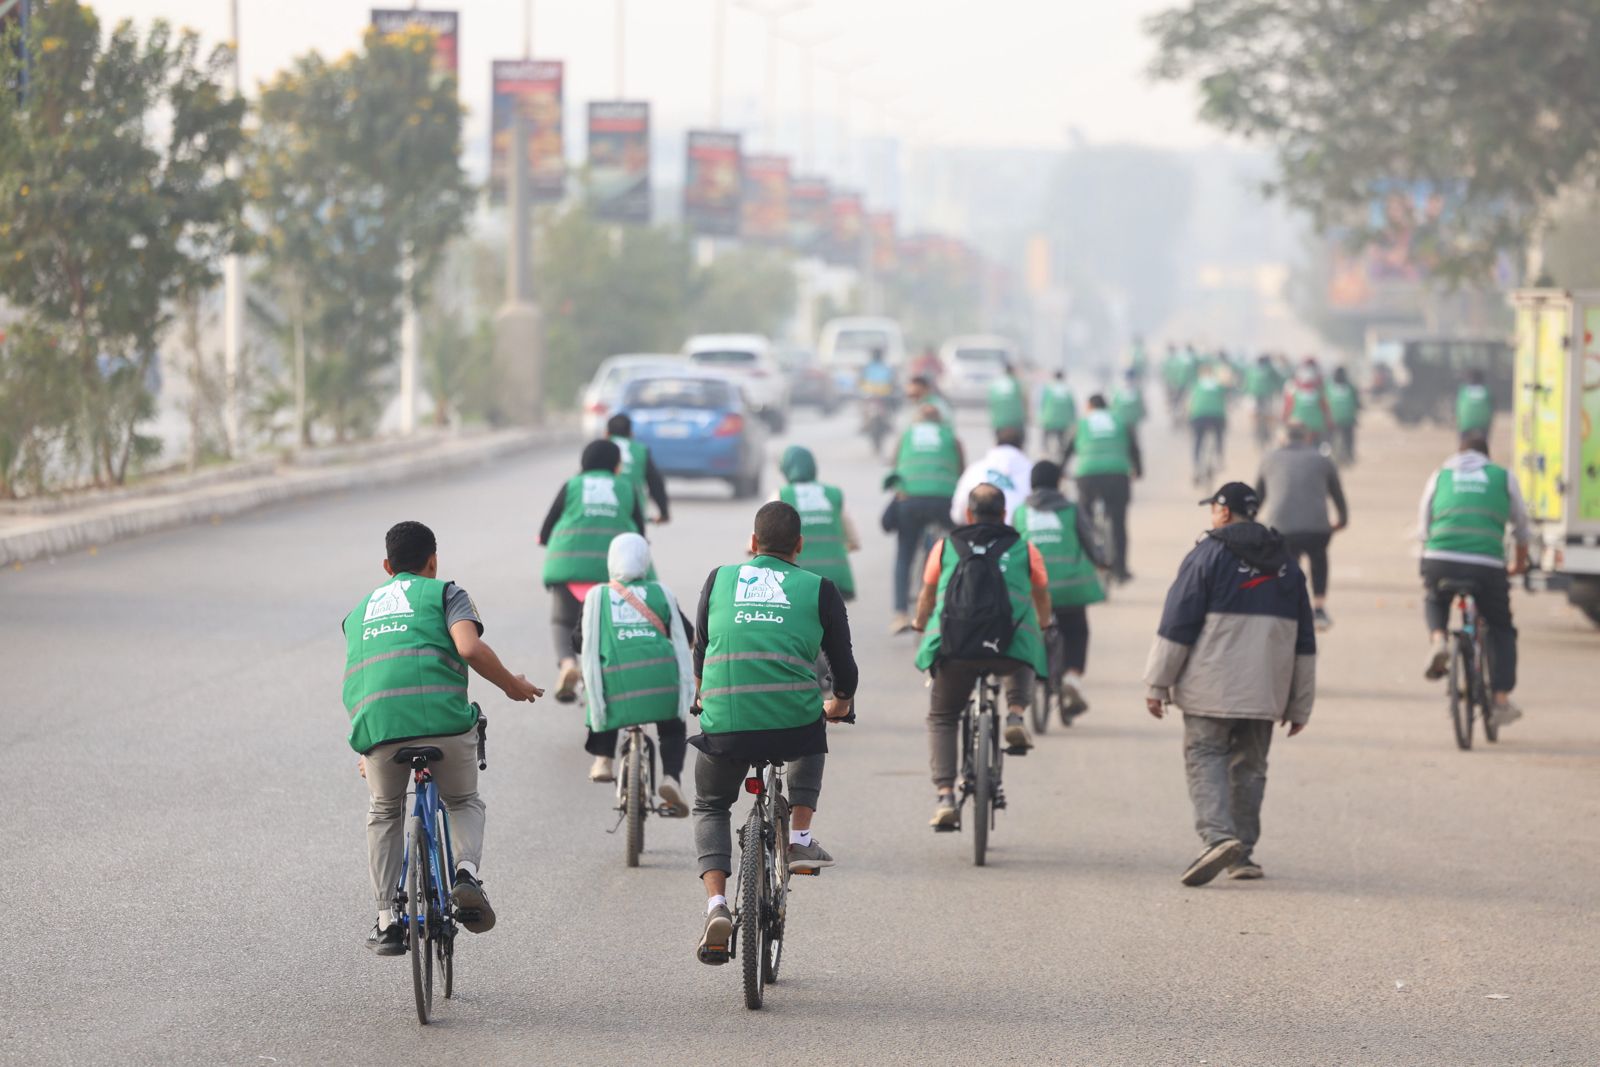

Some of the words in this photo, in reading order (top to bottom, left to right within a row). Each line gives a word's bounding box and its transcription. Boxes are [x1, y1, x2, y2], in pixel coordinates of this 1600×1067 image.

[734, 610, 784, 624] متطوع
[362, 621, 408, 640] متطوع
[617, 628, 656, 640] متطوع
